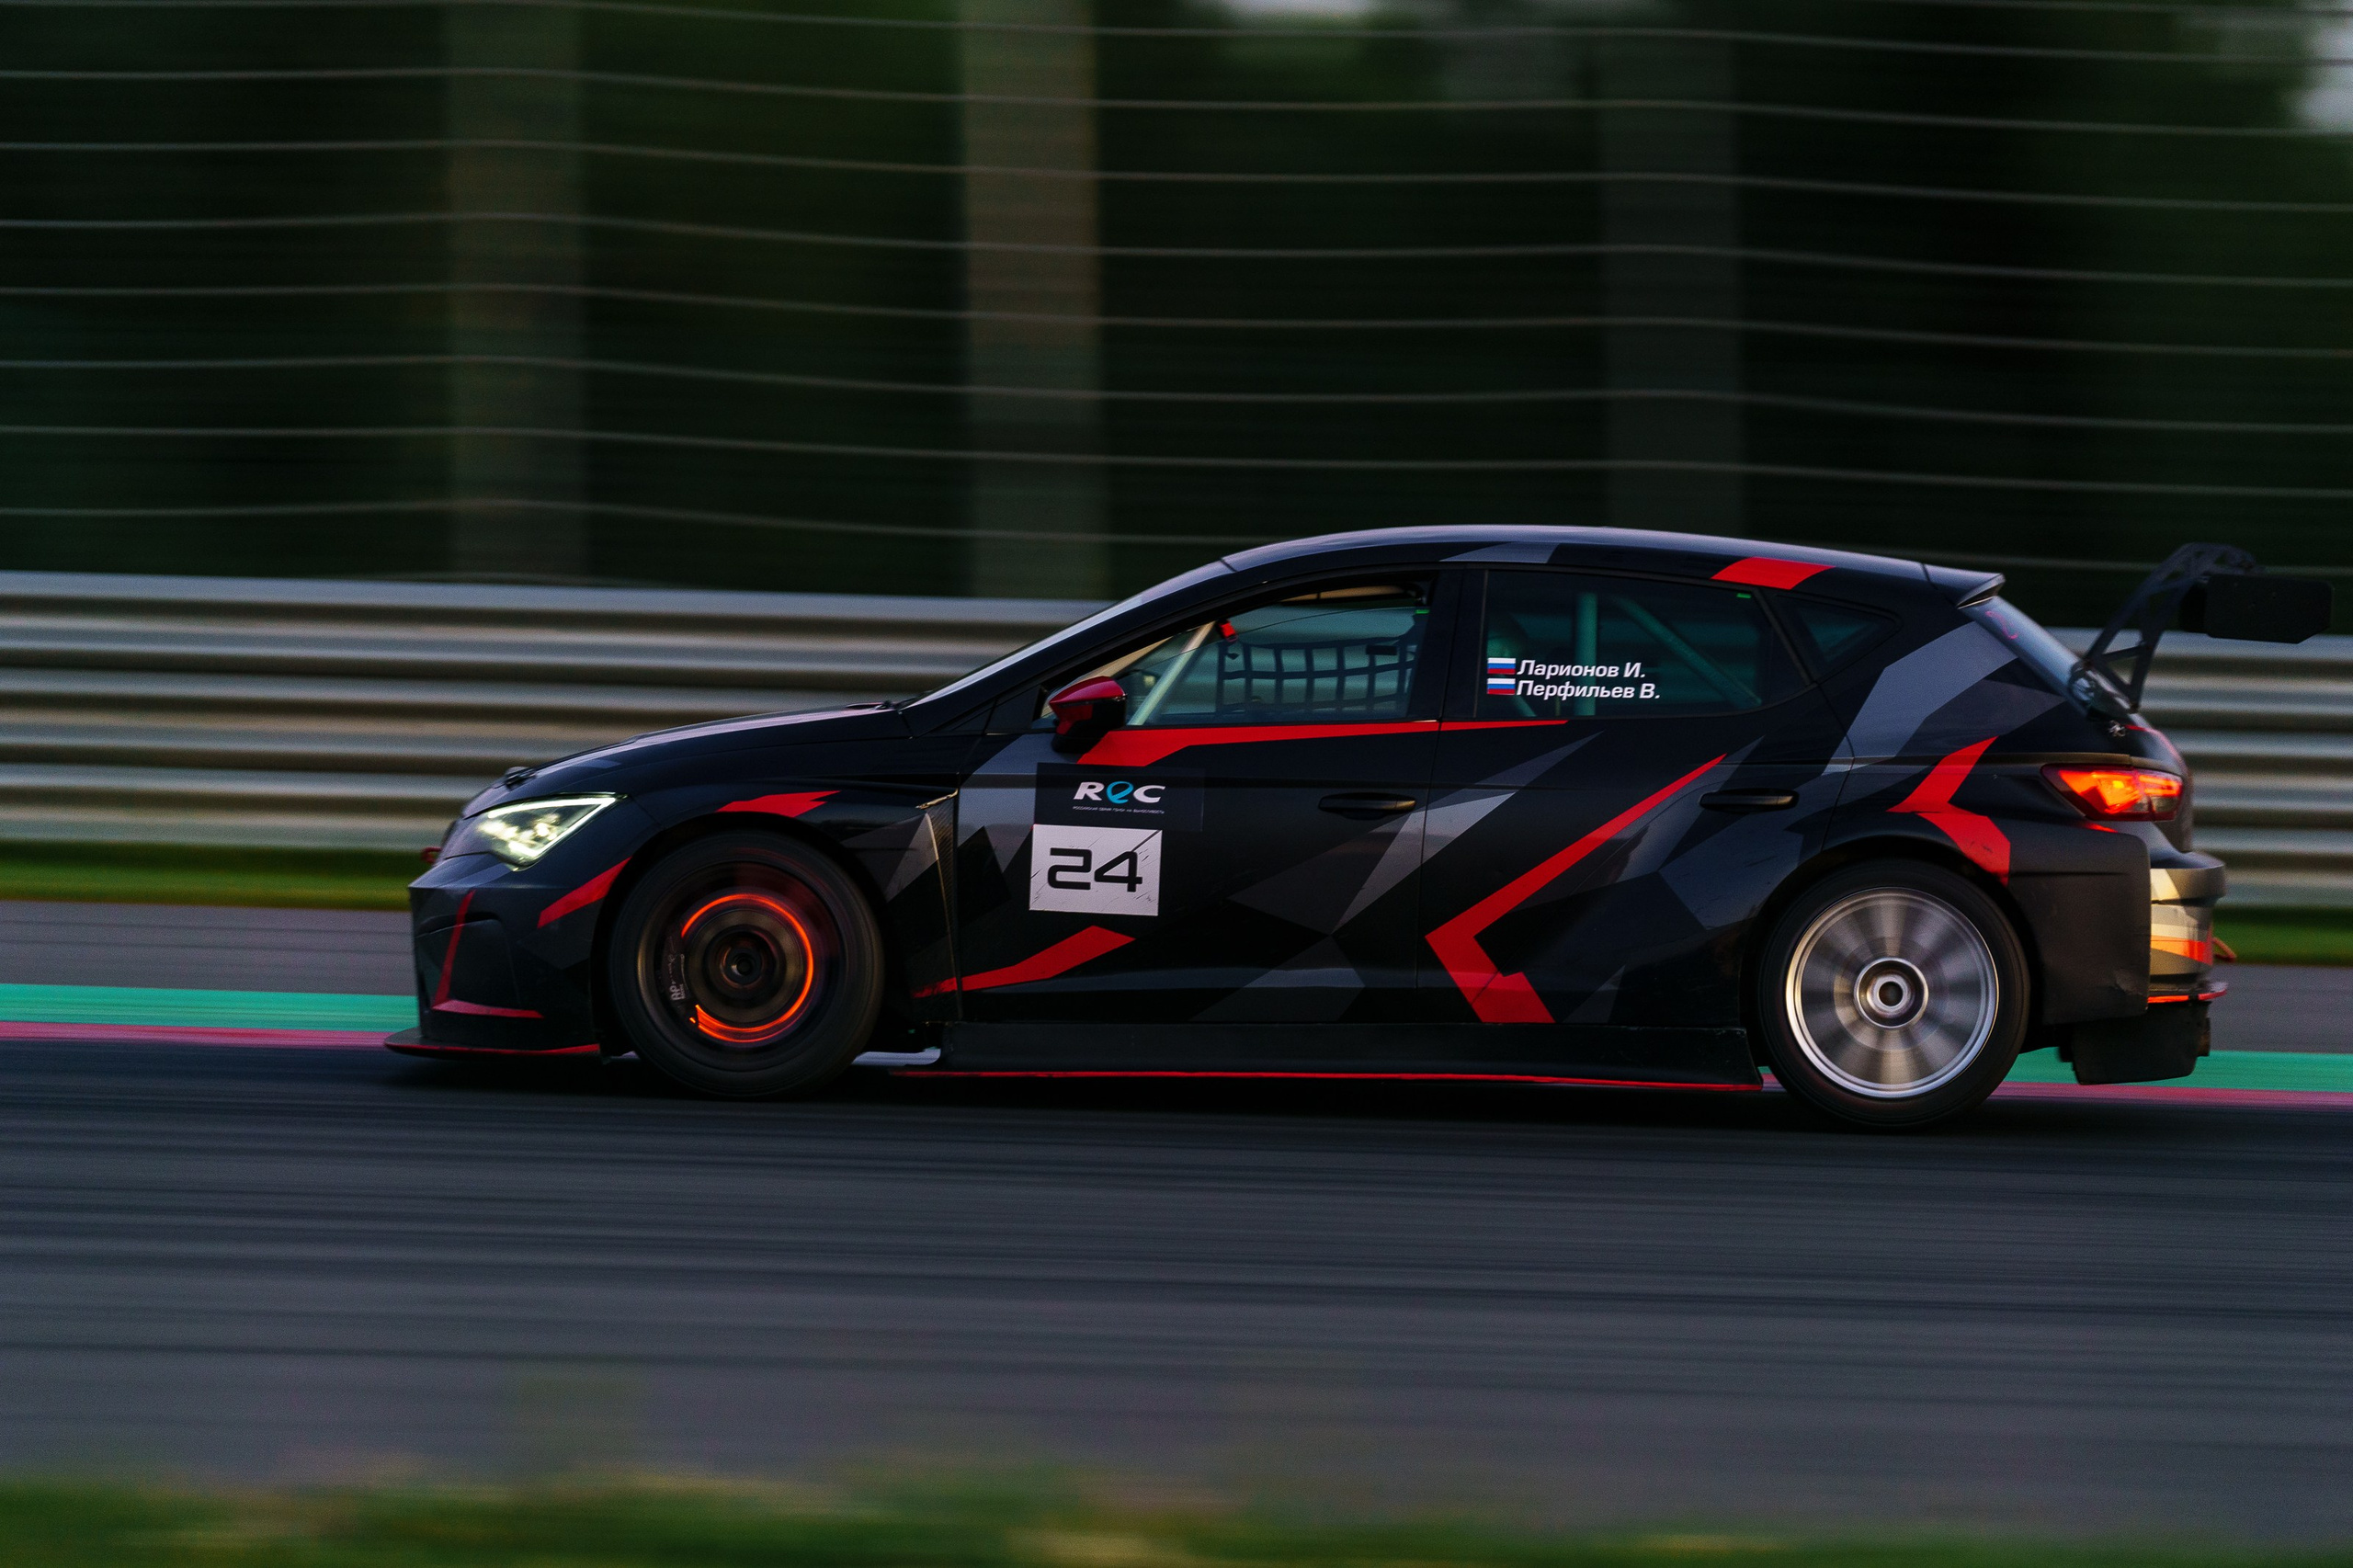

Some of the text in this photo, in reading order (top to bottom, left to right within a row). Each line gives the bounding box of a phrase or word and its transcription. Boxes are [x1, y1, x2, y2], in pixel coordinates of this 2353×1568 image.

[1517, 659, 1646, 679] Ларионов И.
[1517, 680, 1661, 700] Перфильев В.
[1048, 847, 1142, 892] 24
